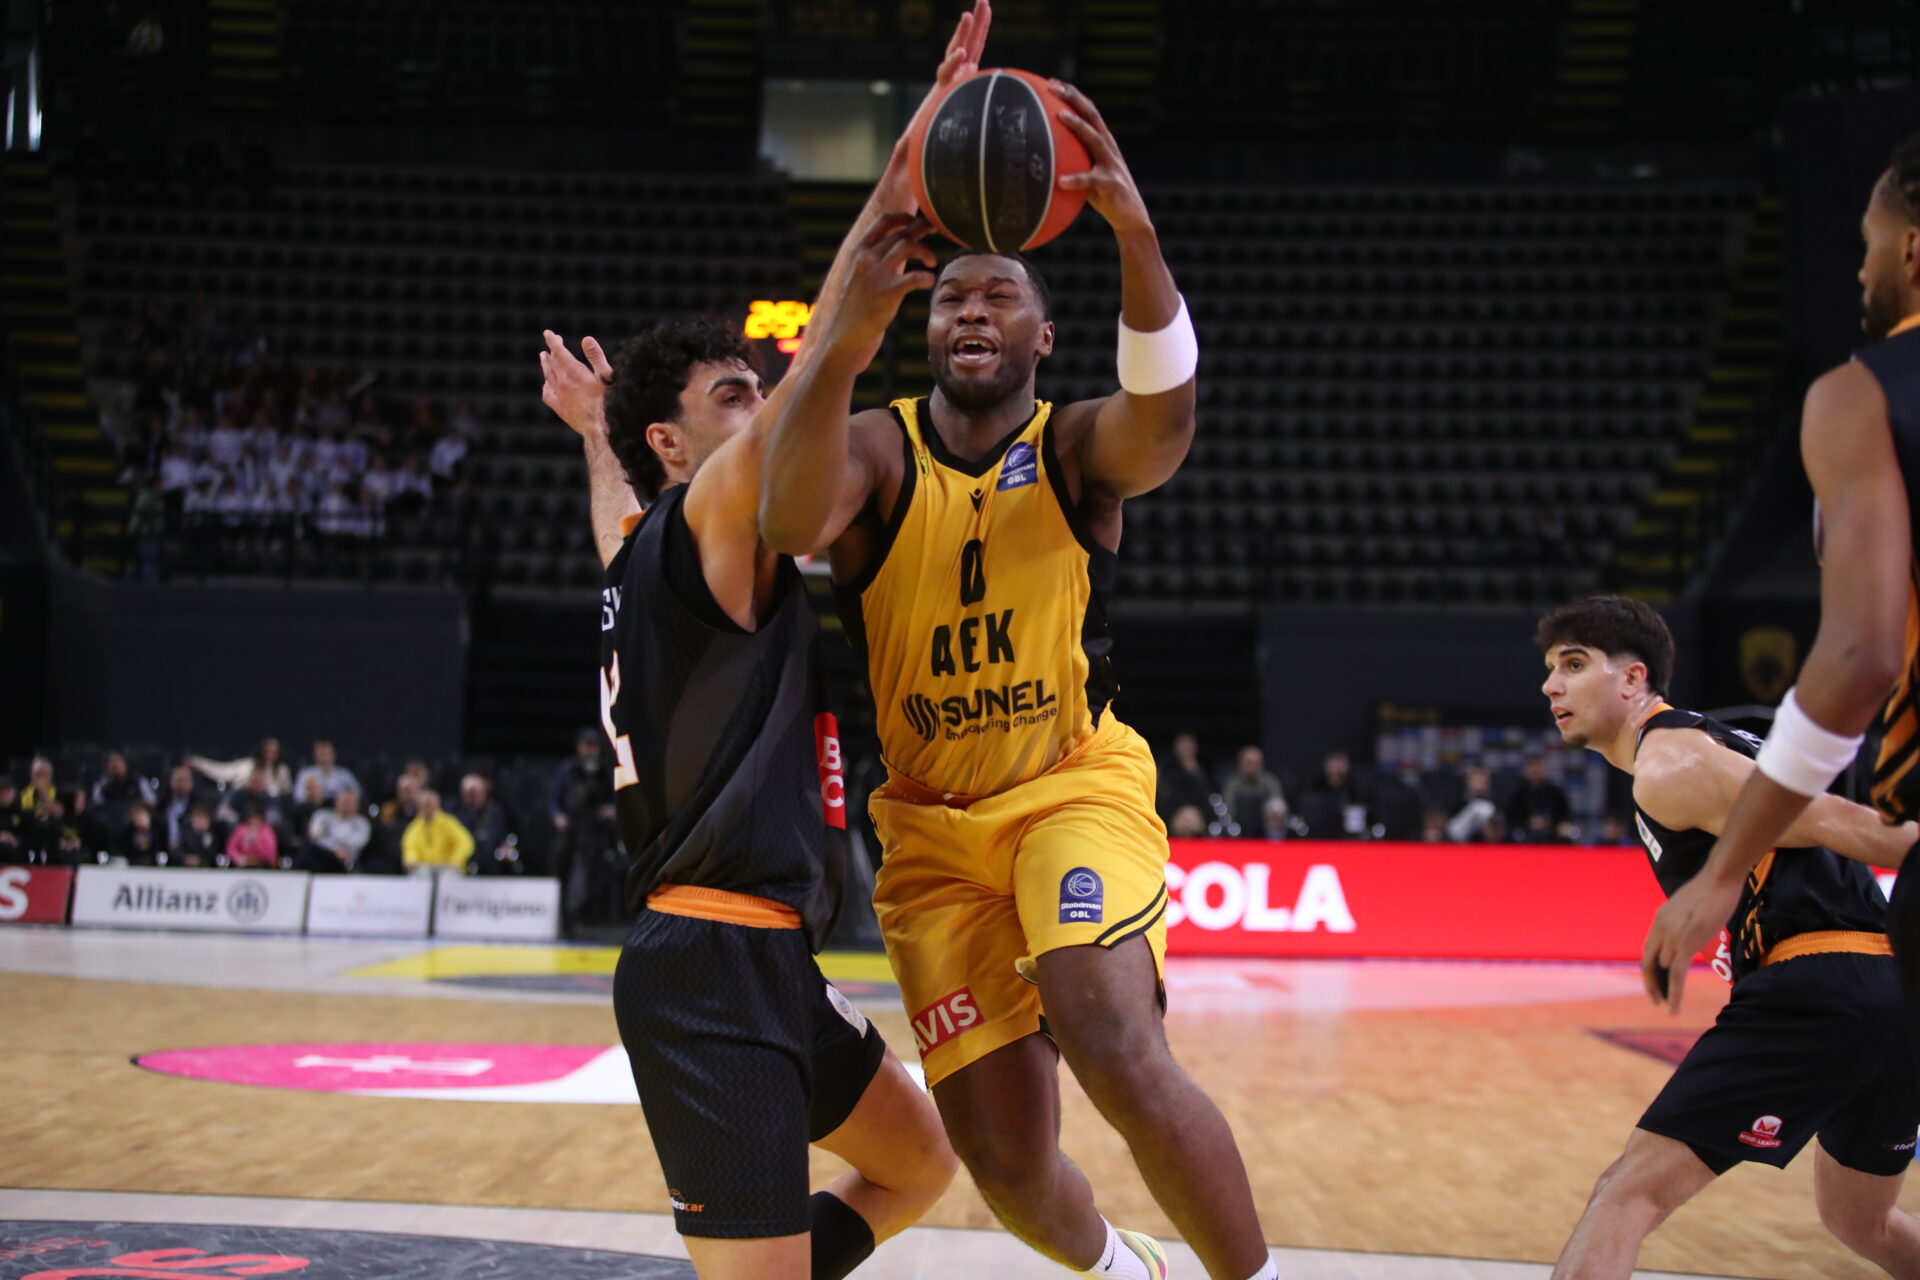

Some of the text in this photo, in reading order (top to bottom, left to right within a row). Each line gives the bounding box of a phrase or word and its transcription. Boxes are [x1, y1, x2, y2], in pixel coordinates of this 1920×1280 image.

[960, 538, 987, 607] 0
[931, 609, 1015, 677] AEK
[942, 680, 1056, 726] SUNEL
[1012, 707, 1057, 728] Change
[113, 884, 220, 912] Allianz
[1069, 910, 1092, 919] GBL
